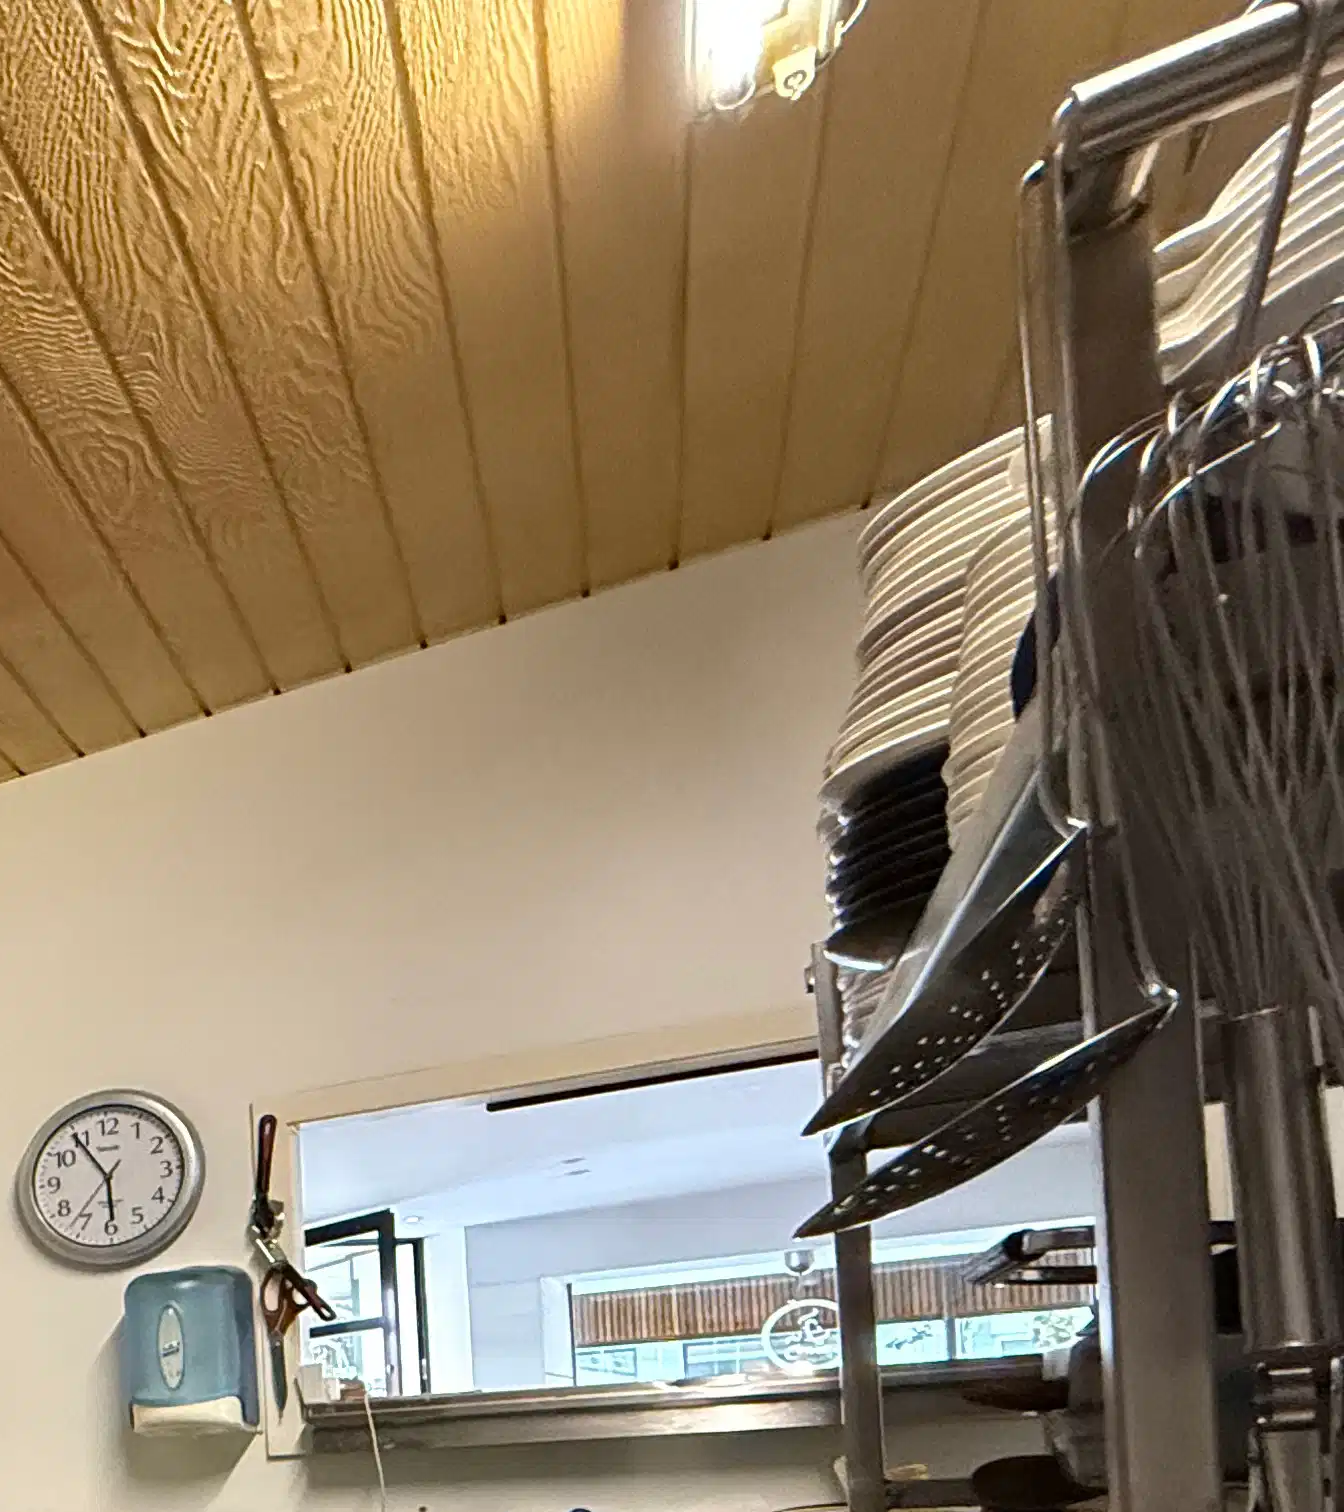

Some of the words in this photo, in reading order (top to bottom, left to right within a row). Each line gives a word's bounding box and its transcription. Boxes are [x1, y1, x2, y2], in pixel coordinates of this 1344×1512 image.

[96, 1117, 120, 1136] 12
[130, 1122, 141, 1139] 1
[72, 1130, 90, 1148] 11
[150, 1136, 164, 1155] 2
[55, 1150, 76, 1168] 10
[160, 1160, 173, 1178] 3
[47, 1176, 61, 1194] 9
[151, 1186, 165, 1204] 4
[57, 1199, 71, 1217] 8
[130, 1206, 144, 1224] 5
[78, 1213, 93, 1230] 7
[104, 1219, 118, 1235] 6
